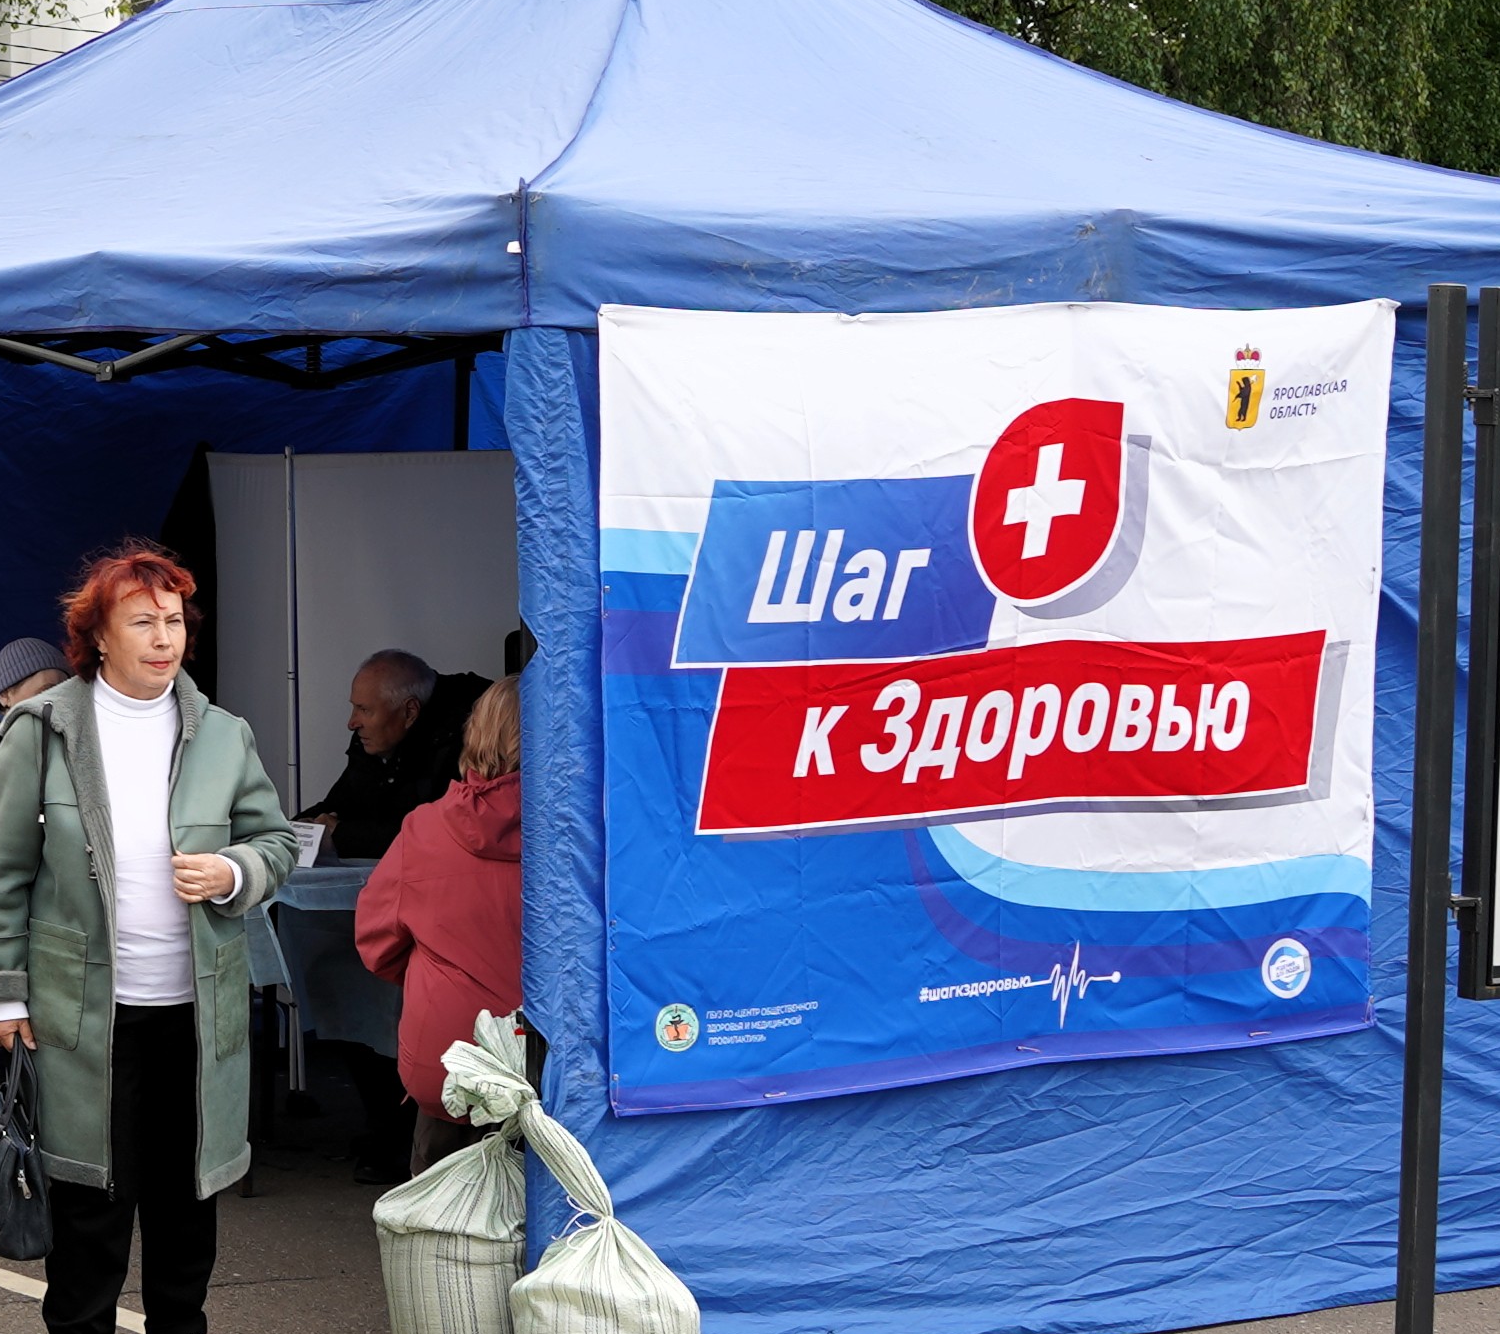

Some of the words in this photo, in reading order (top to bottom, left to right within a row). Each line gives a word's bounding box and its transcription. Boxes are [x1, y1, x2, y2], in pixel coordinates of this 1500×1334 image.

[1269, 402, 1317, 420] ОБЛАСТЬ
[747, 529, 930, 624] Шаг
[792, 704, 850, 778] к
[859, 678, 1251, 784] Здоровью
[919, 975, 1032, 1003] #шагкздоровью
[761, 1001, 819, 1016] ОБЩЕСТВЕННОГО
[706, 1022, 743, 1033] ЗДОРОВЬЯ
[751, 1015, 802, 1029] МЕДИЦИНСКОЙ
